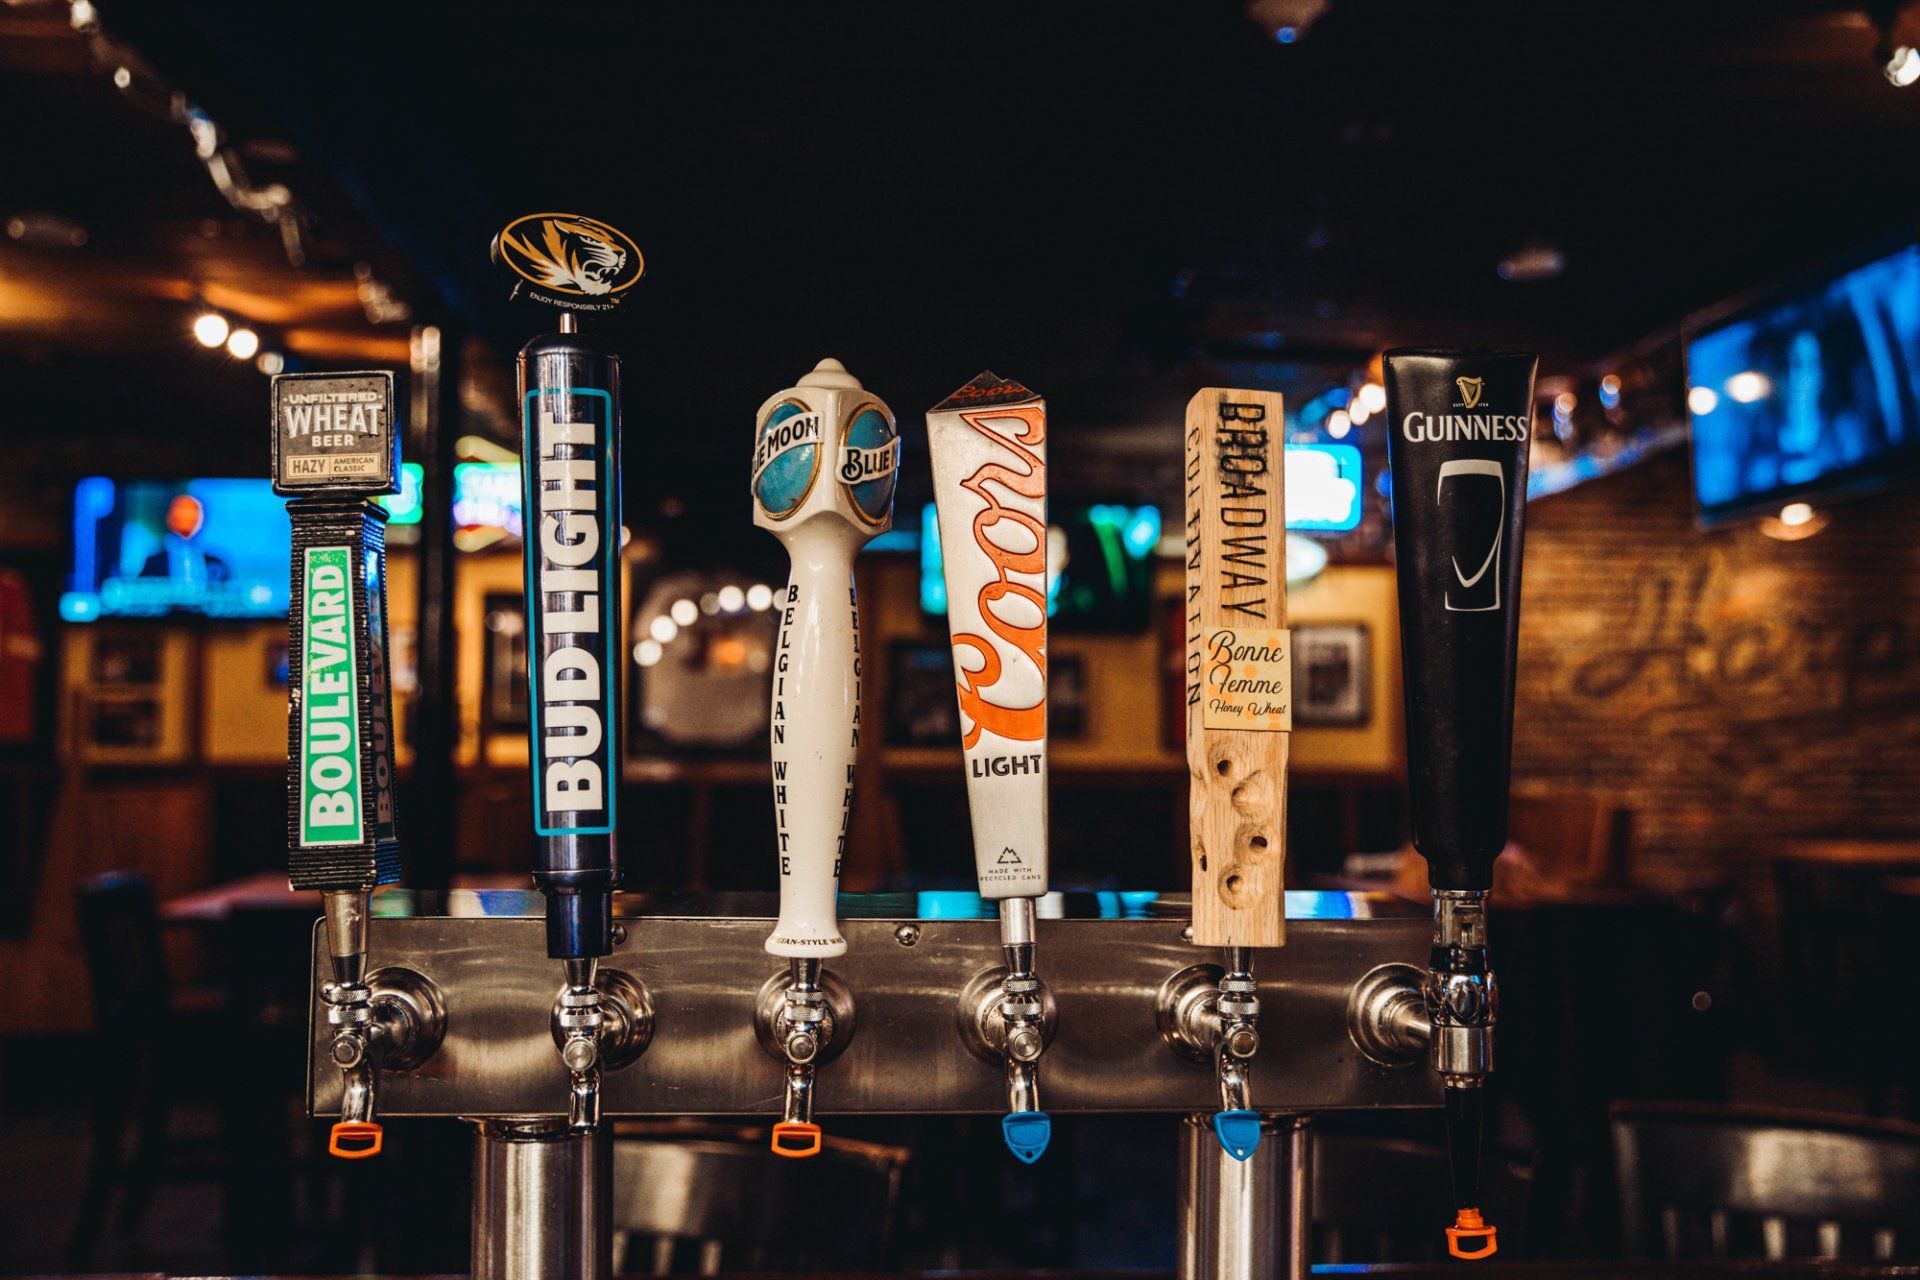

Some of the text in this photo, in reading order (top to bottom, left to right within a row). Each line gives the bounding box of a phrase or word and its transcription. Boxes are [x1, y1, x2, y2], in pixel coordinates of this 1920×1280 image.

[530, 291, 553, 304] ENJOY
[553, 299, 602, 311] RESPONSIBLY
[288, 392, 378, 404] UNFILTERED
[284, 403, 383, 439] WHEAT
[1403, 411, 1528, 443] GUINNESS
[311, 434, 355, 448] BEER
[768, 416, 819, 459] MOON
[292, 458, 326, 474] HAZY
[333, 457, 375, 465] AMERICAN
[333, 465, 366, 473] CLASSIC
[841, 449, 890, 481] BLUE
[1217, 401, 1269, 620] BROADWAY
[952, 406, 1046, 749] Coors
[540, 411, 603, 812] BUD LIGHT
[1208, 630, 1285, 665] Bonne
[1209, 664, 1284, 695] Femme
[309, 564, 355, 828] BOULEVARD
[1209, 698, 1287, 717] Honey Wheat
[773, 584, 799, 876] BELGIAN WHITE
[832, 587, 862, 878] BELGIAN WHITE
[972, 754, 1042, 778] LIGHT
